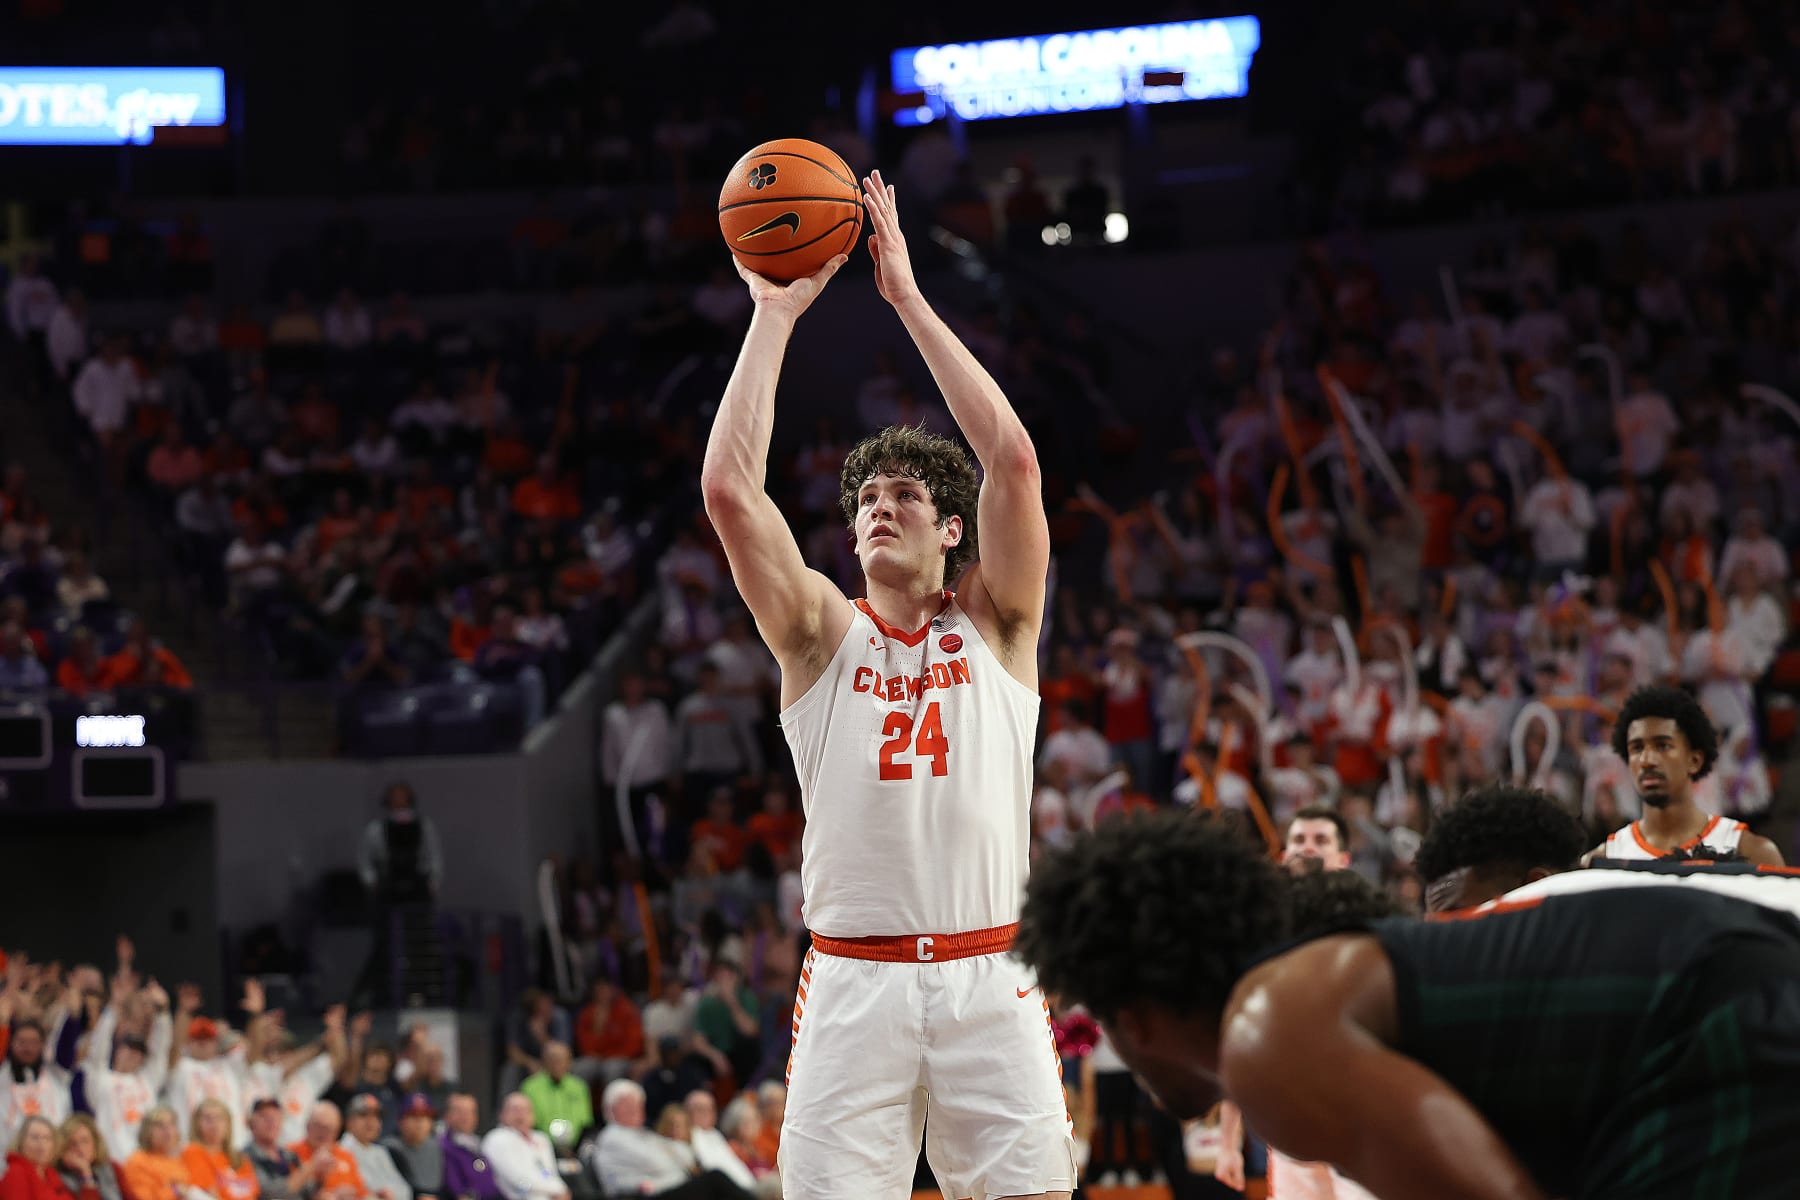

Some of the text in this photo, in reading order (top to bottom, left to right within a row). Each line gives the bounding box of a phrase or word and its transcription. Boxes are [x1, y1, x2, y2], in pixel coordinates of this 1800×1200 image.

[853, 657, 971, 702] CLEMSON
[879, 702, 949, 780] 24
[916, 937, 934, 960] C
